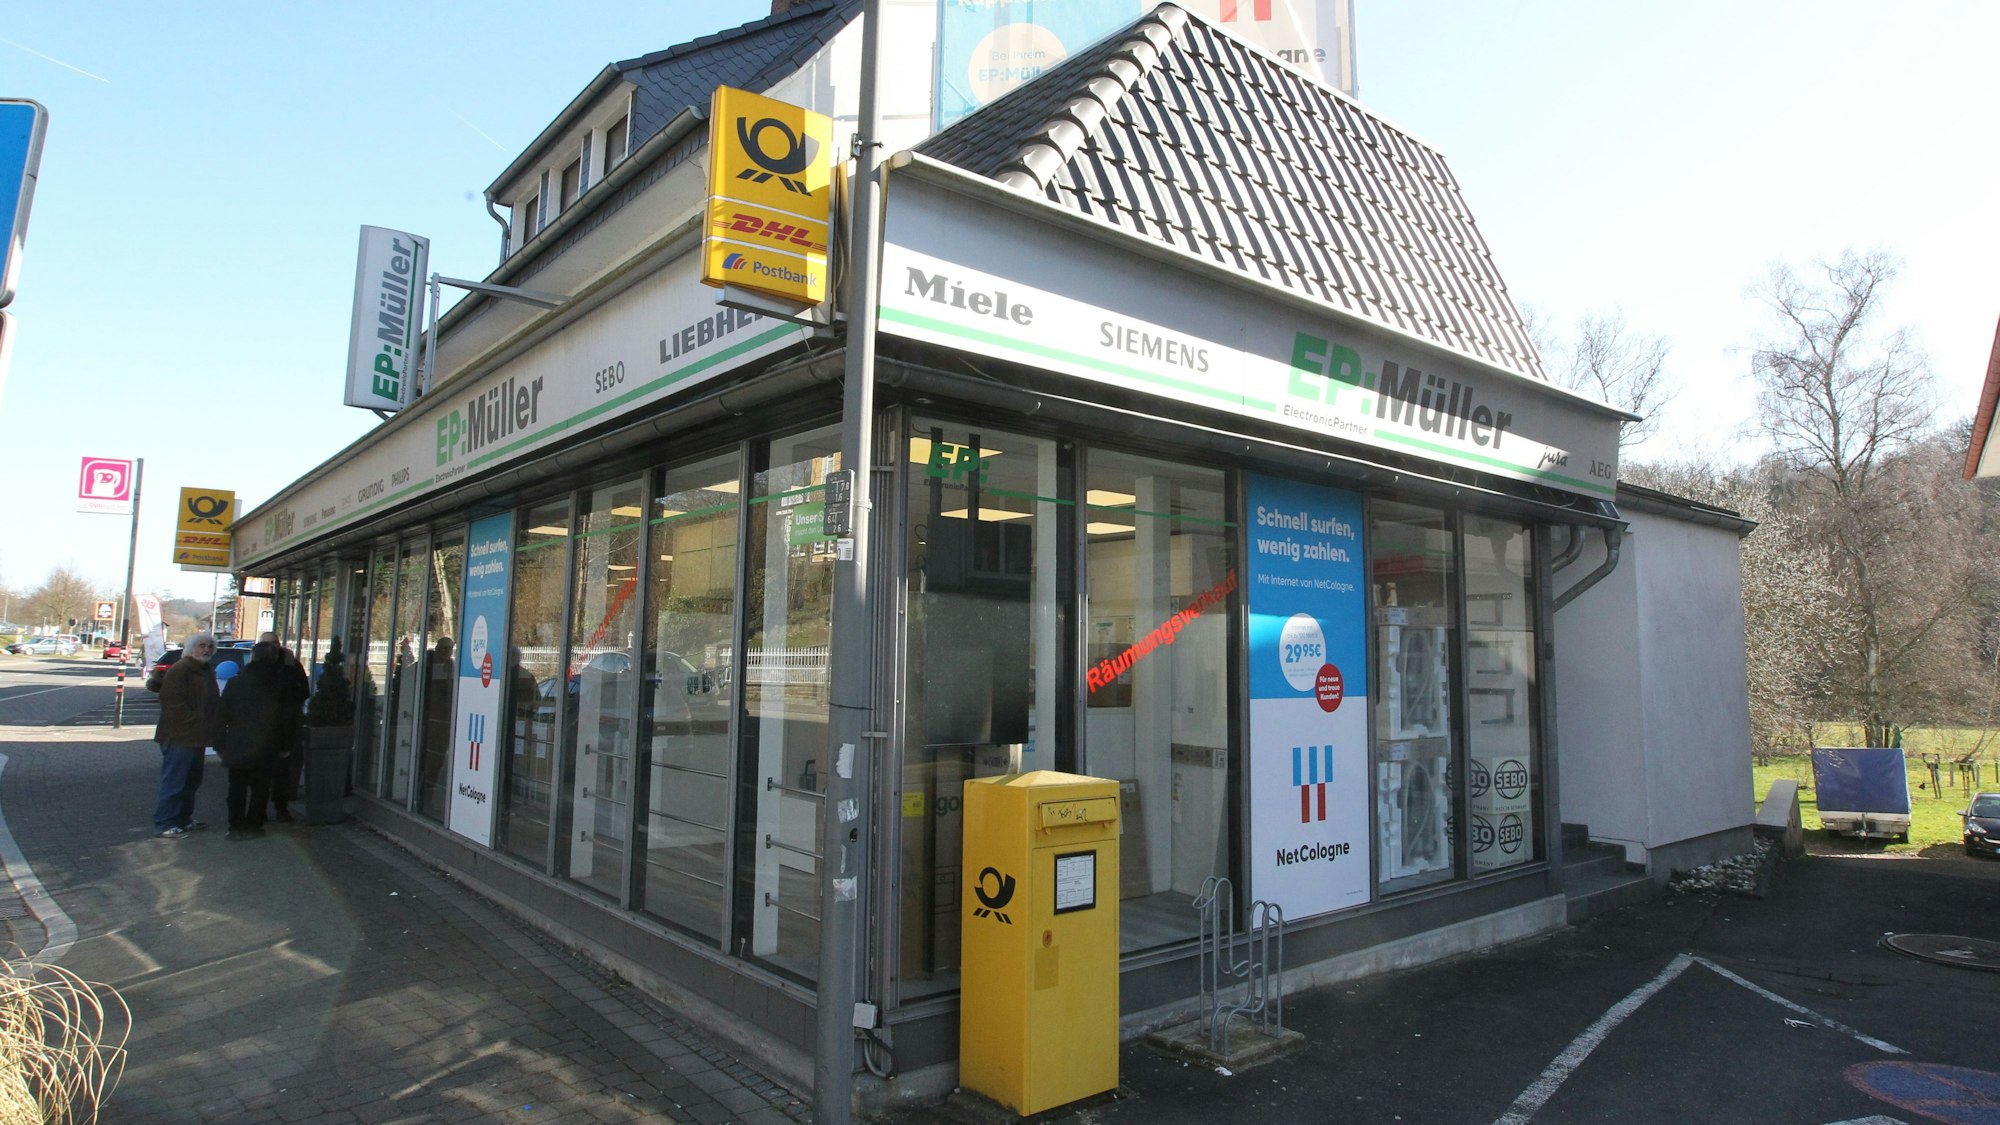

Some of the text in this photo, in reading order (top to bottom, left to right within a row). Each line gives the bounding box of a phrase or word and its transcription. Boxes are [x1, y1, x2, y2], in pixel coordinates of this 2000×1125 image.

[730, 213, 814, 247] DHL
[752, 260, 817, 287] Postbank
[904, 266, 1034, 325] Miele
[372, 237, 411, 402] EP:Müller
[660, 308, 763, 364] LIEBHE
[1099, 321, 1209, 373] SIEMENS
[595, 360, 625, 394] SEBO
[1287, 330, 1513, 449] EP:Müller
[436, 375, 543, 467] EP:Müller
[1283, 403, 1368, 436] ElectronicPartner
[927, 442, 990, 484] EP:
[1537, 445, 1568, 469] jura
[391, 466, 410, 487] PHILIPS
[1589, 460, 1613, 480] AEG
[358, 478, 384, 503] GRUNDIG
[796, 514, 818, 526] Unser
[1257, 505, 1355, 541] Schnell surfen,
[183, 536, 222, 545] DHL
[470, 540, 489, 558] Schnell
[1257, 537, 1350, 563] wenig zahlen.
[469, 562, 485, 579] wenig
[1257, 573, 1270, 584] Mit
[1271, 575, 1299, 587] Internet
[1300, 579, 1313, 588] von
[1495, 771, 1526, 788] SEBO
[458, 782, 486, 804] NetCologne
[1500, 825, 1521, 843] SEBO
[1276, 842, 1350, 867] NetCologne
